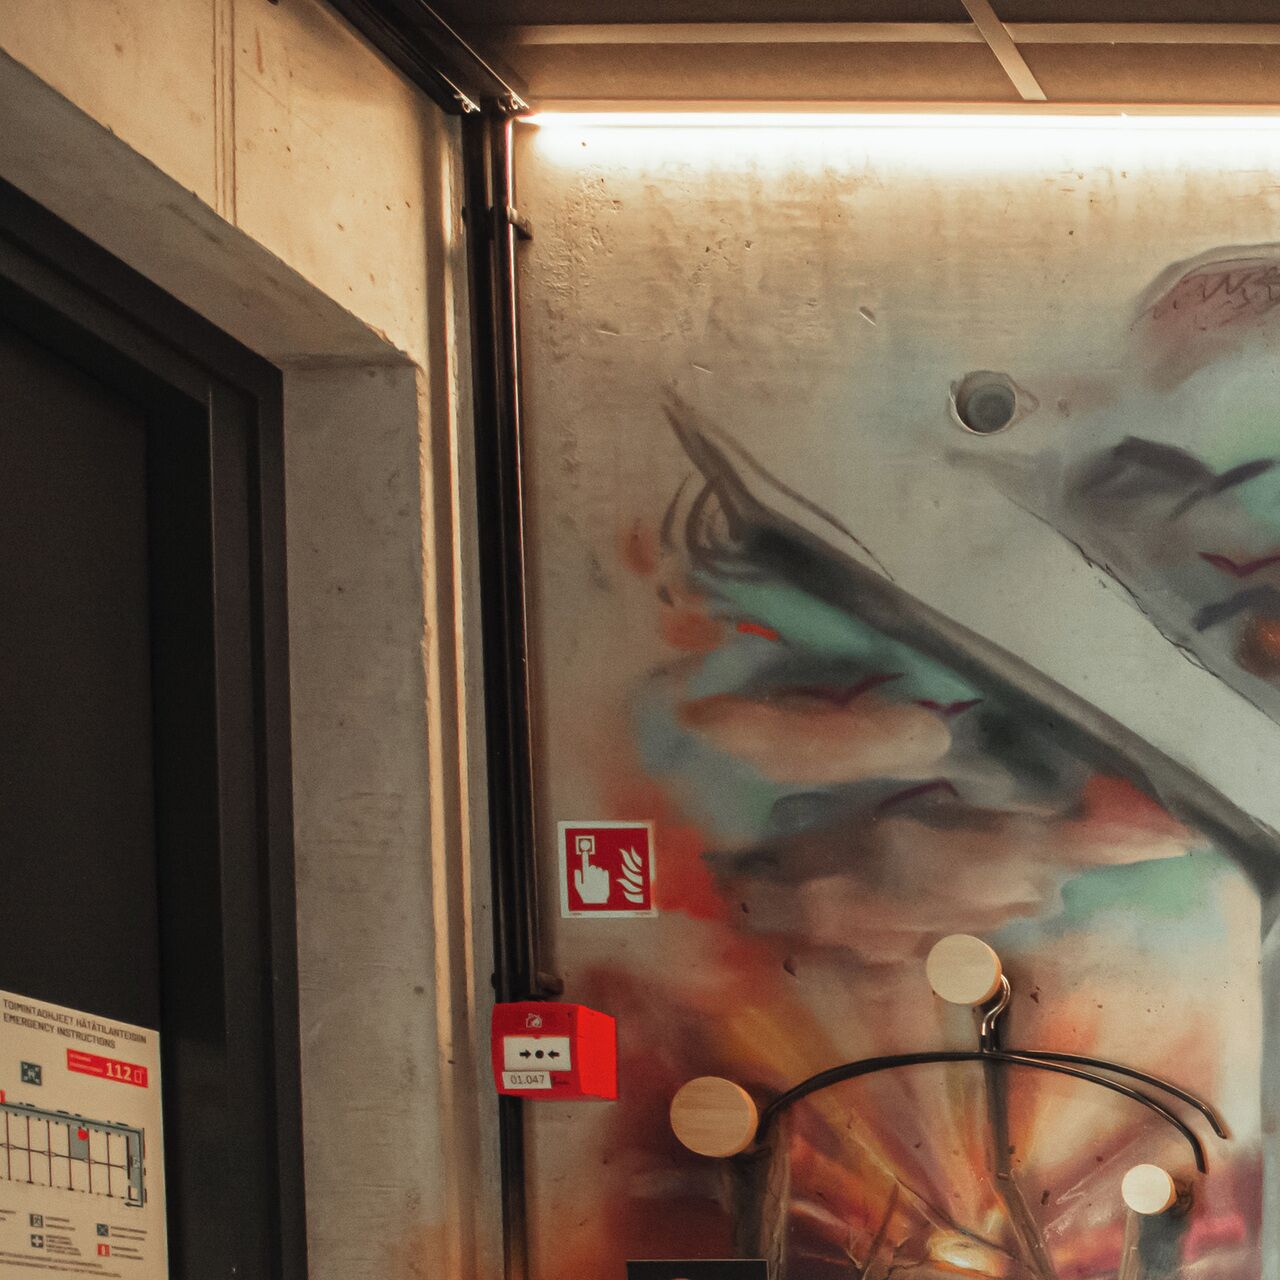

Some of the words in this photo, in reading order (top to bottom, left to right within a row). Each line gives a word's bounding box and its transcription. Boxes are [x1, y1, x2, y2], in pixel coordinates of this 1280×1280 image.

[3, 999, 74, 1026] TOIMINTAOHJEET
[3, 1013, 55, 1033] EMERGENCY
[57, 1027, 116, 1049] INSTRUCTIONS
[105, 1062, 132, 1081] 112
[510, 1074, 545, 1085] 01.047
